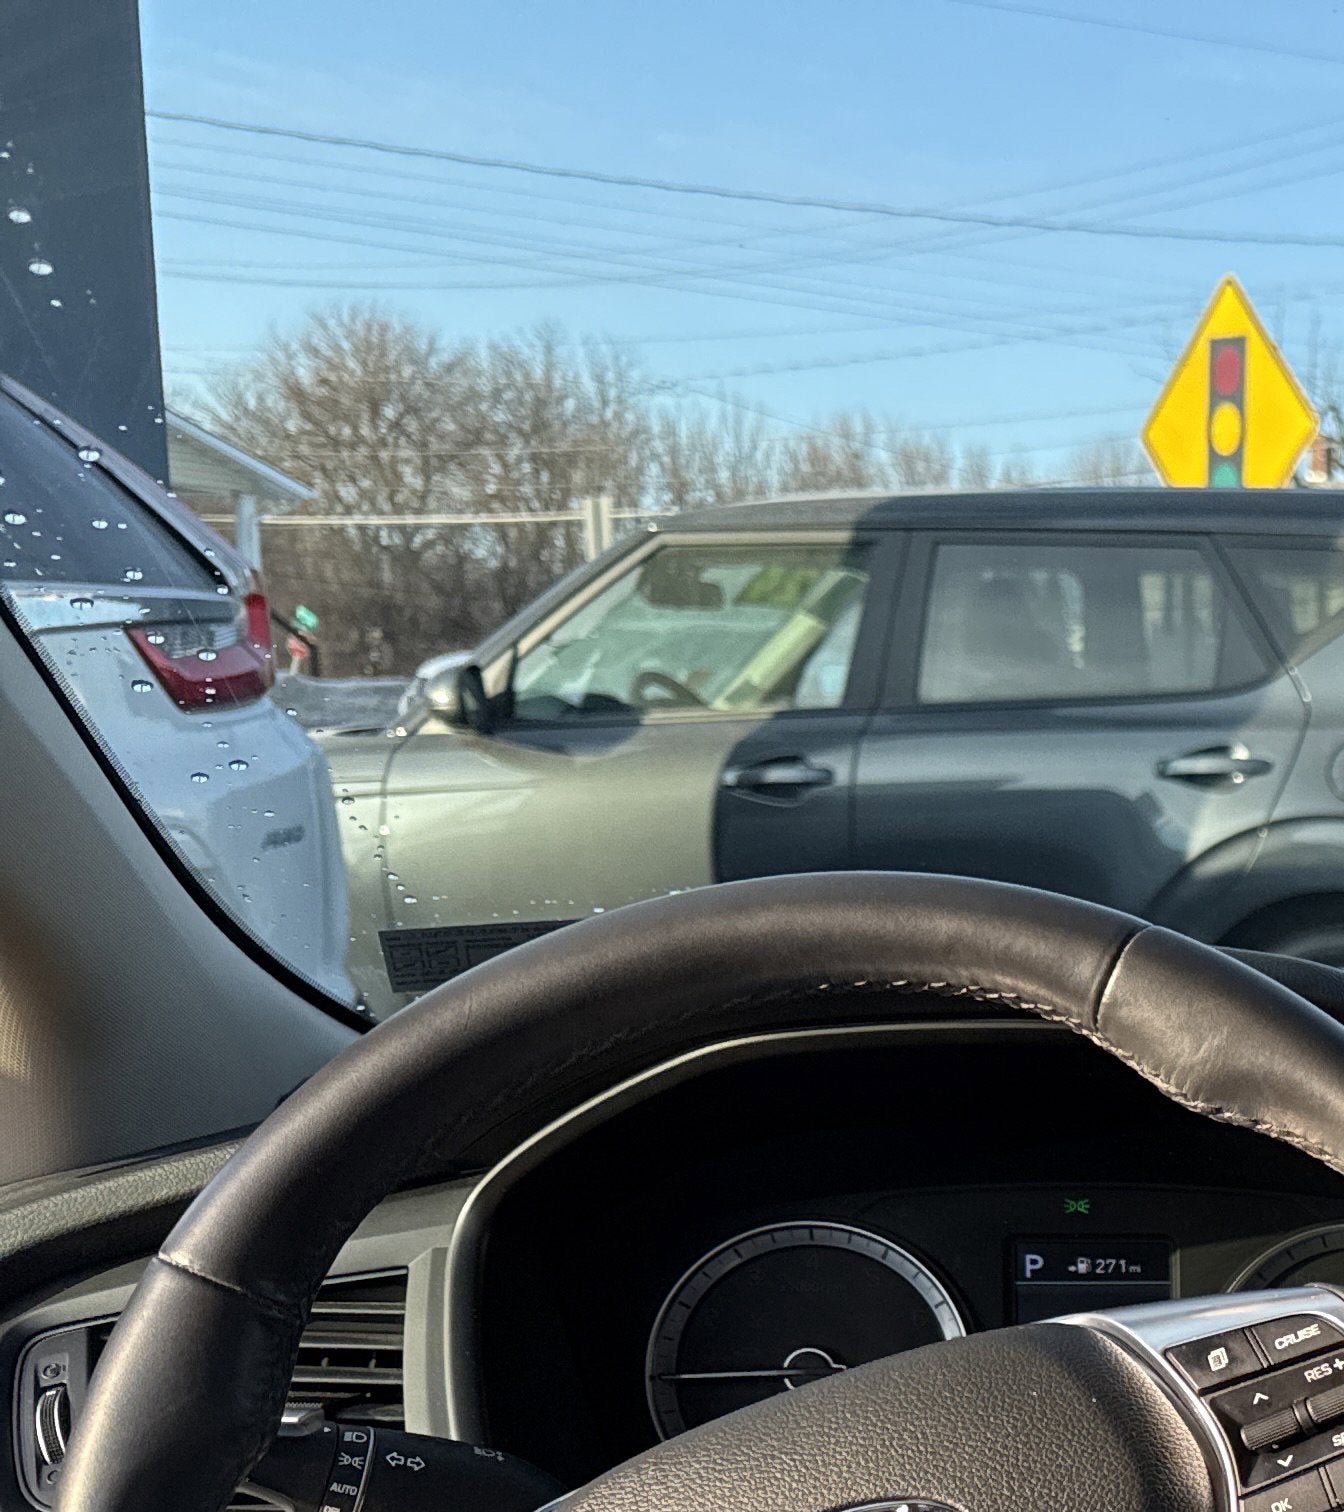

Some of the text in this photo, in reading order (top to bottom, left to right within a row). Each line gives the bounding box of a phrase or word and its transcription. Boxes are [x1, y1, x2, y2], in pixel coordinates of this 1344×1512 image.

[1024, 1253, 1045, 1279] P
[1095, 1258, 1127, 1275] 271
[1274, 1324, 1322, 1350] CRUISE
[1303, 1362, 1333, 1383] RES
[329, 1481, 358, 1496] AUTO
